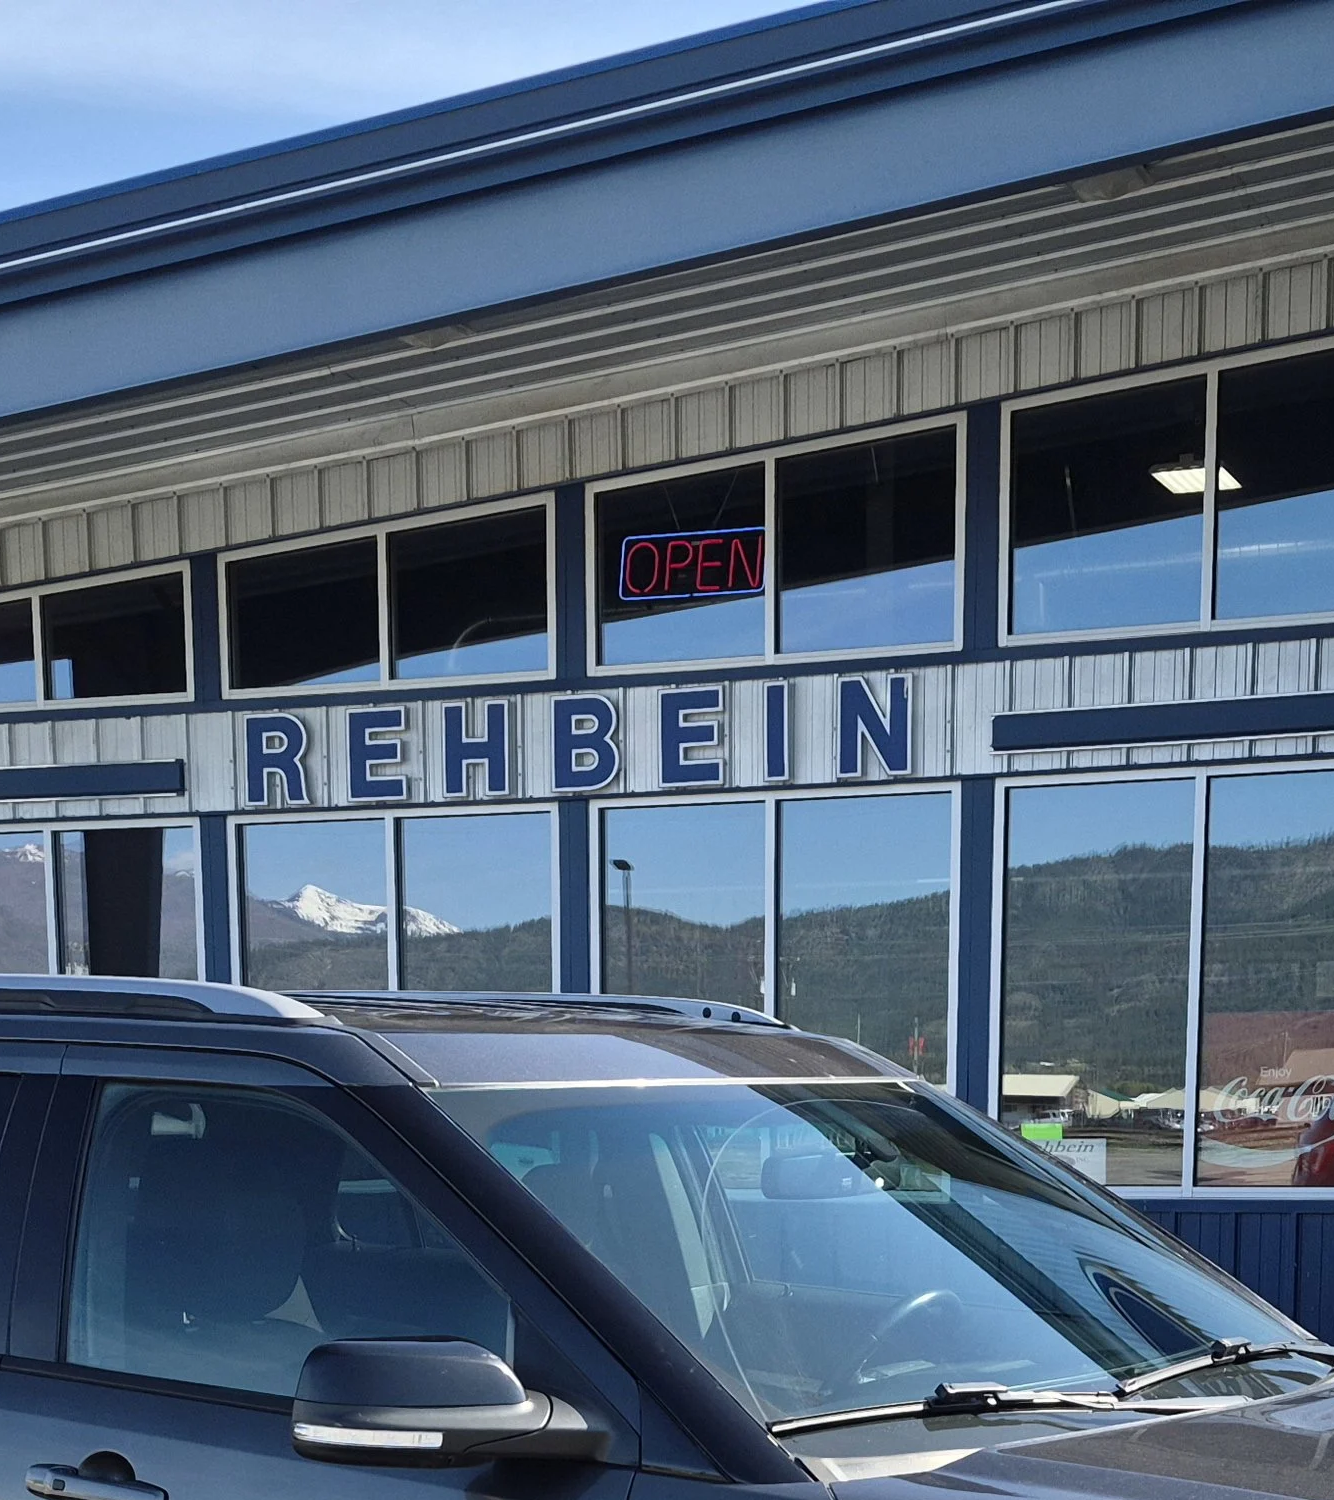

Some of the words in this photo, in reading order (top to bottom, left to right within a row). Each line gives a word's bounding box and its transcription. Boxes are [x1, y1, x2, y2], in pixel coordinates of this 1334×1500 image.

[624, 535, 763, 594] OPEN
[243, 672, 913, 806] REHBEIN
[1260, 1066, 1292, 1080] Enjoy
[1037, 1140, 1095, 1154] hbein
